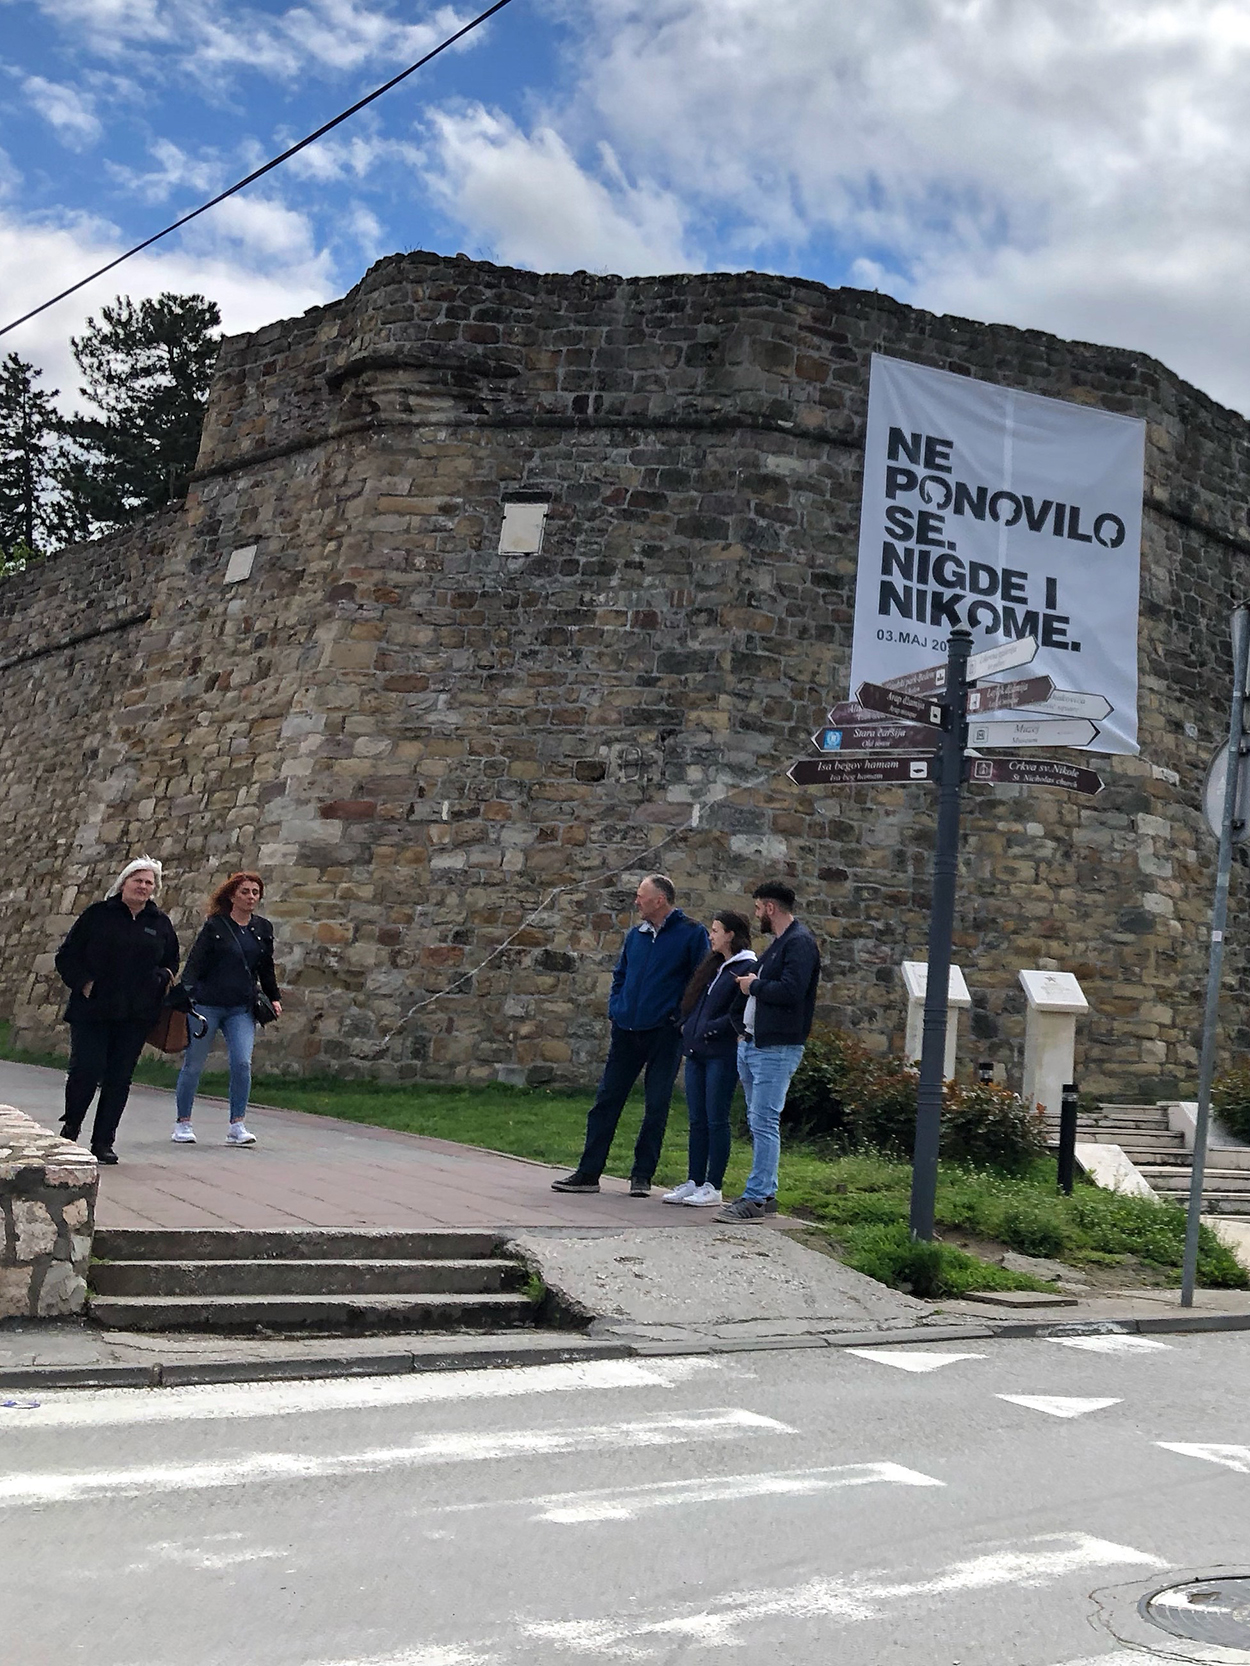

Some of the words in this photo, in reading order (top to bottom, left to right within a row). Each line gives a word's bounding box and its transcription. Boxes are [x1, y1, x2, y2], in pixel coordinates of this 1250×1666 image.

[887, 426, 954, 474] NE
[885, 465, 1126, 549] PONOVILO
[884, 504, 957, 552] SE.
[881, 541, 1029, 606] NIGDE
[1045, 576, 1058, 611] I
[878, 579, 1082, 652] NIKOME.
[876, 629, 928, 648] 03.MAJ
[931, 639, 948, 652] 20
[853, 727, 876, 738] Stara
[1014, 723, 1040, 735] Muzej
[861, 739, 875, 748] Old
[1012, 736, 1038, 744] Museum
[817, 761, 832, 771] Isa
[834, 760, 863, 772] begov
[864, 759, 899, 769] hamam
[1008, 760, 1037, 771] Crkva
[856, 772, 883, 780] hamam
[1023, 774, 1055, 784] Nicholas
[1055, 778, 1078, 788] church
